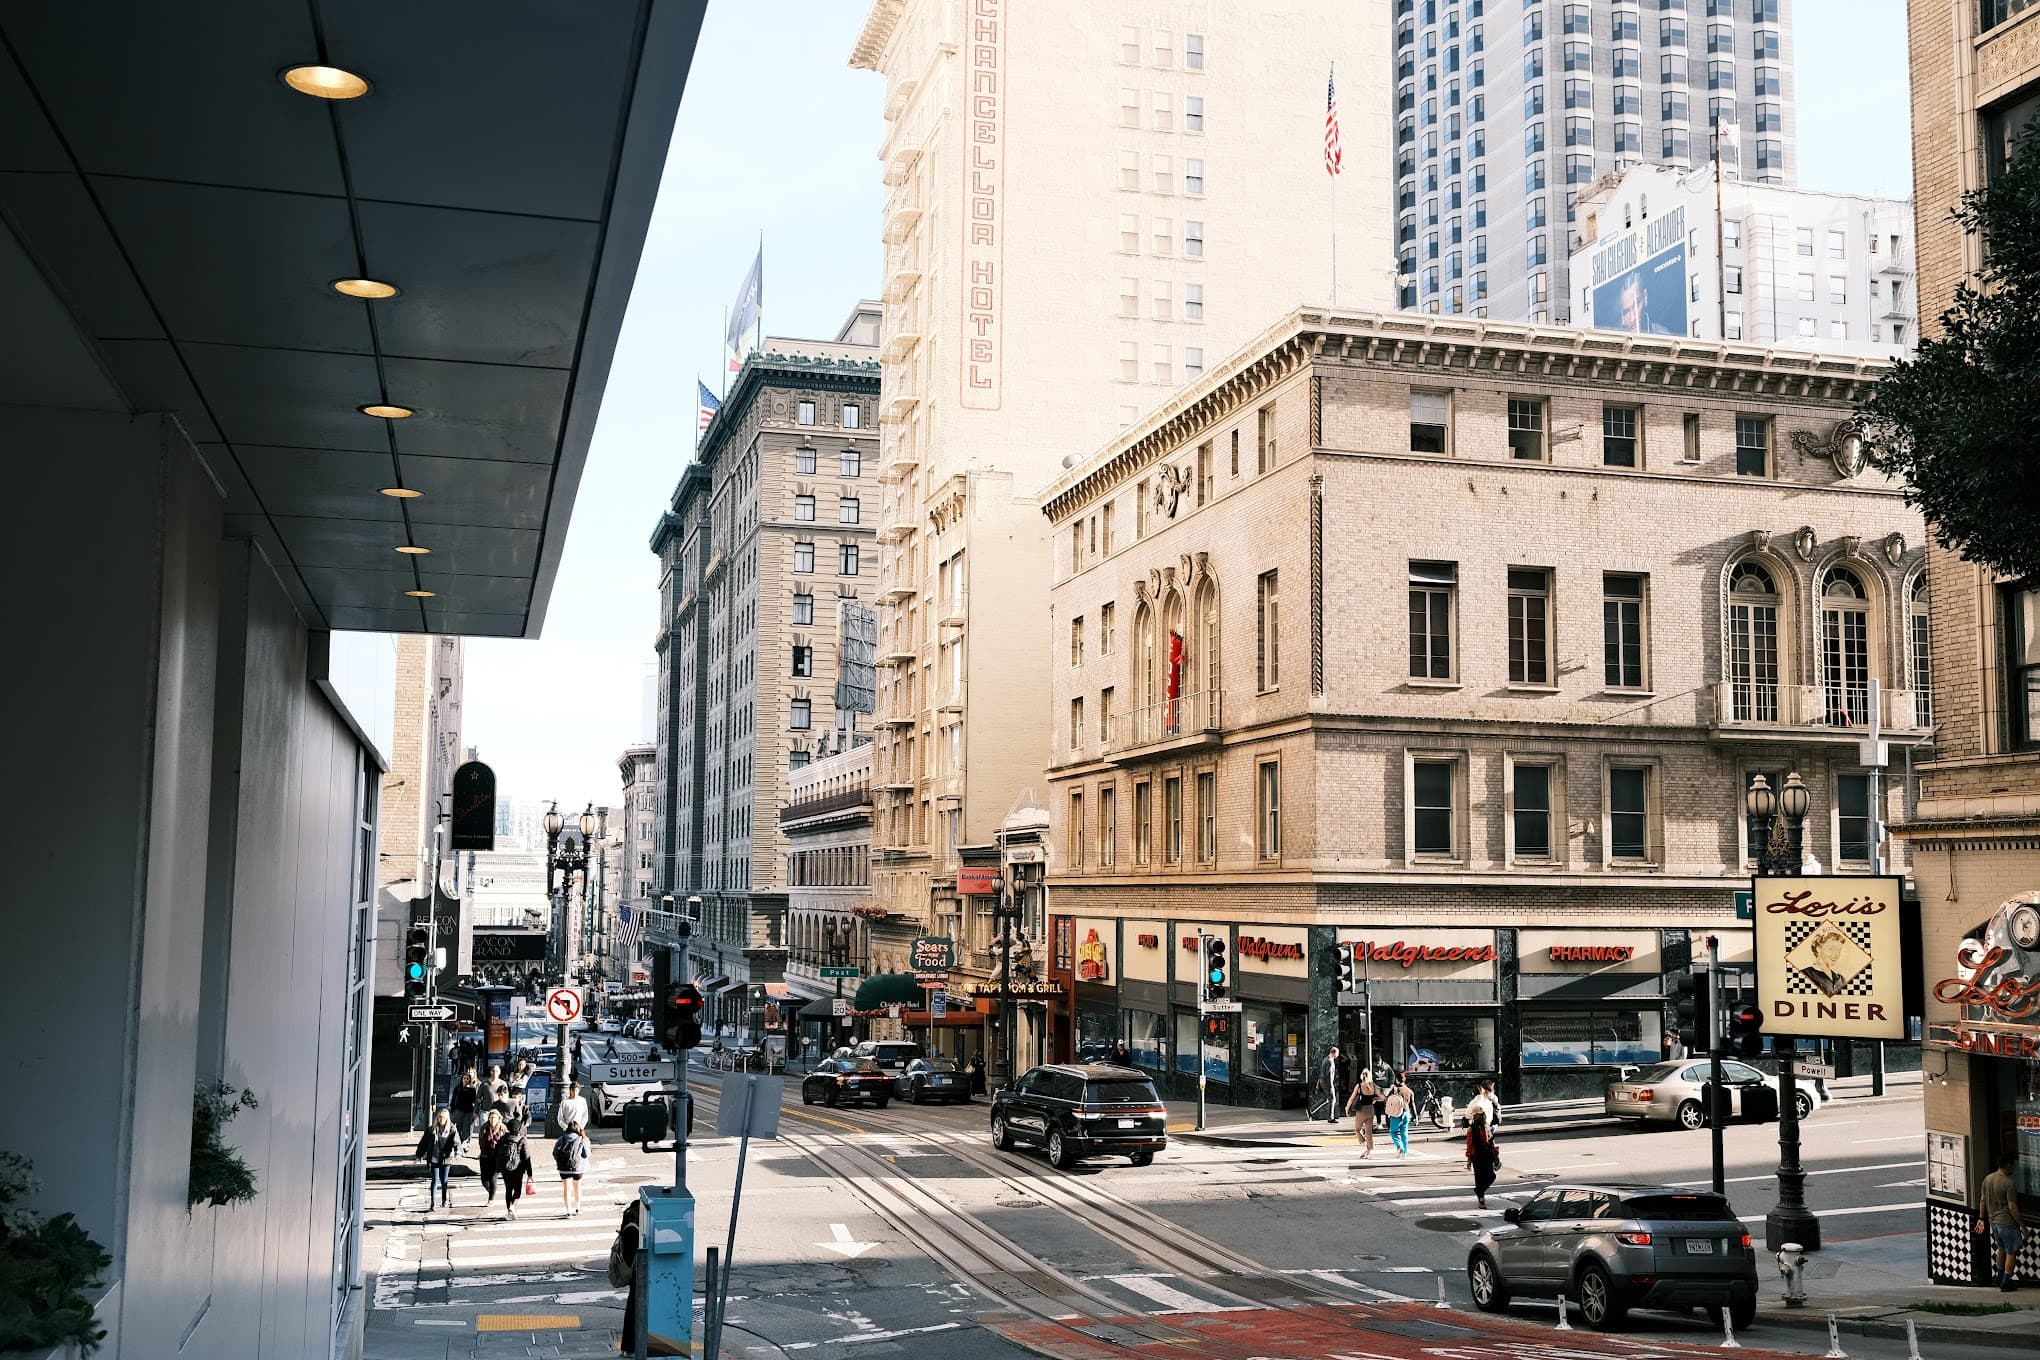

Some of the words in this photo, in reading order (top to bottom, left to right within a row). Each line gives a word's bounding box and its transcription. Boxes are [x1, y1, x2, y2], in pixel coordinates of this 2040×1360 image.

[971, 0, 998, 246] CHANCELLOR
[1646, 205, 1685, 257] ALEXANDER
[970, 260, 994, 389] HOTEL
[1766, 890, 1887, 917] Lori's
[416, 915, 457, 926] BECON
[473, 936, 516, 947] EACON
[916, 940, 949, 953] Sears
[1237, 935, 1303, 961] Walgreens
[915, 953, 947, 967] Food
[1344, 941, 1499, 968] Walgreens
[1550, 946, 1635, 962] PHARMACY
[979, 983, 996, 993] TAP
[1036, 983, 1063, 993] GRILL
[1774, 1000, 1887, 1021] DINER
[1961, 1030, 2038, 1058] DINER
[621, 1054, 637, 1062] 500
[609, 1067, 657, 1078] Sutter
[1801, 1066, 1826, 1076] Powell
[2018, 1116, 2040, 1128] OPE
